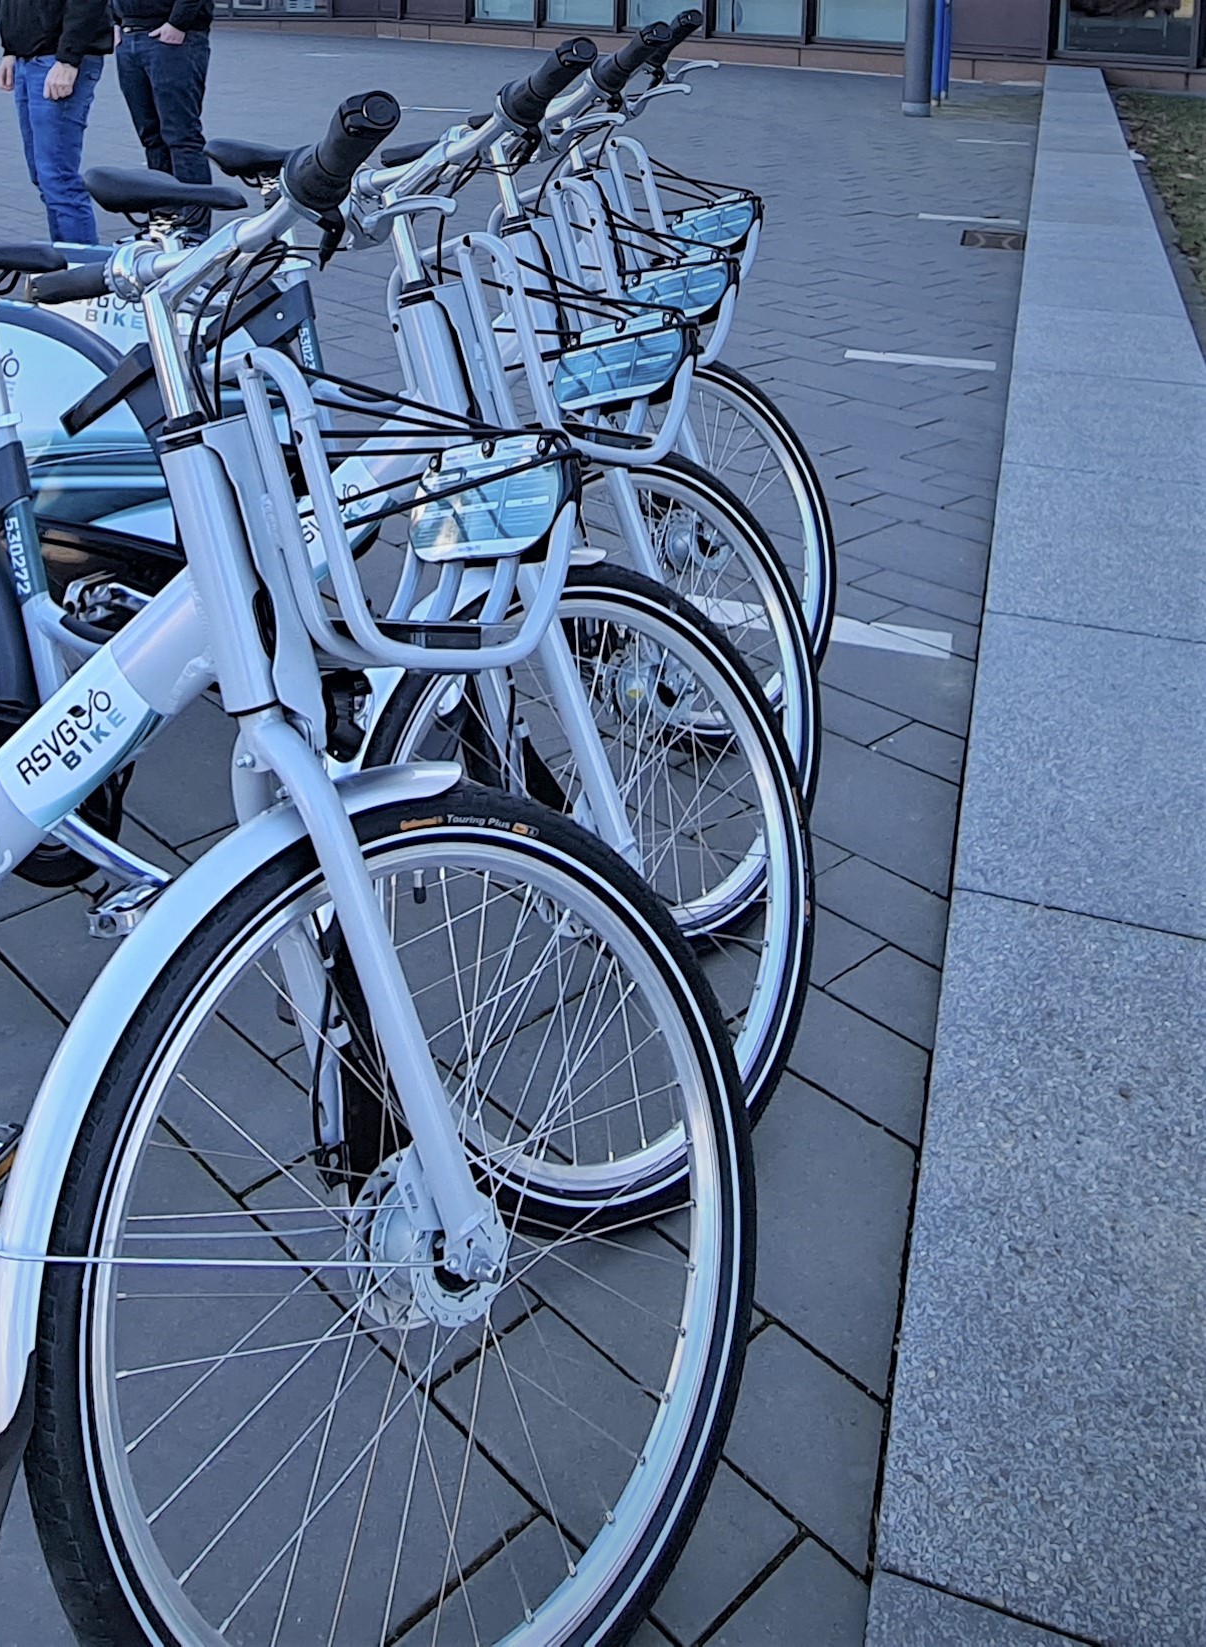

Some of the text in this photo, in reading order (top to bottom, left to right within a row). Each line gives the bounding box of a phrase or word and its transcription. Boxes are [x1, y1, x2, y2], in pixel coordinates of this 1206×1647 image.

[85, 308, 144, 330] BIKE
[298, 327, 317, 370] 53027
[4, 516, 32, 595] 530272
[16, 718, 78, 786] RSVG
[61, 707, 127, 772] BIKE
[446, 814, 486, 827] Touring
[487, 817, 511, 830] Plus
